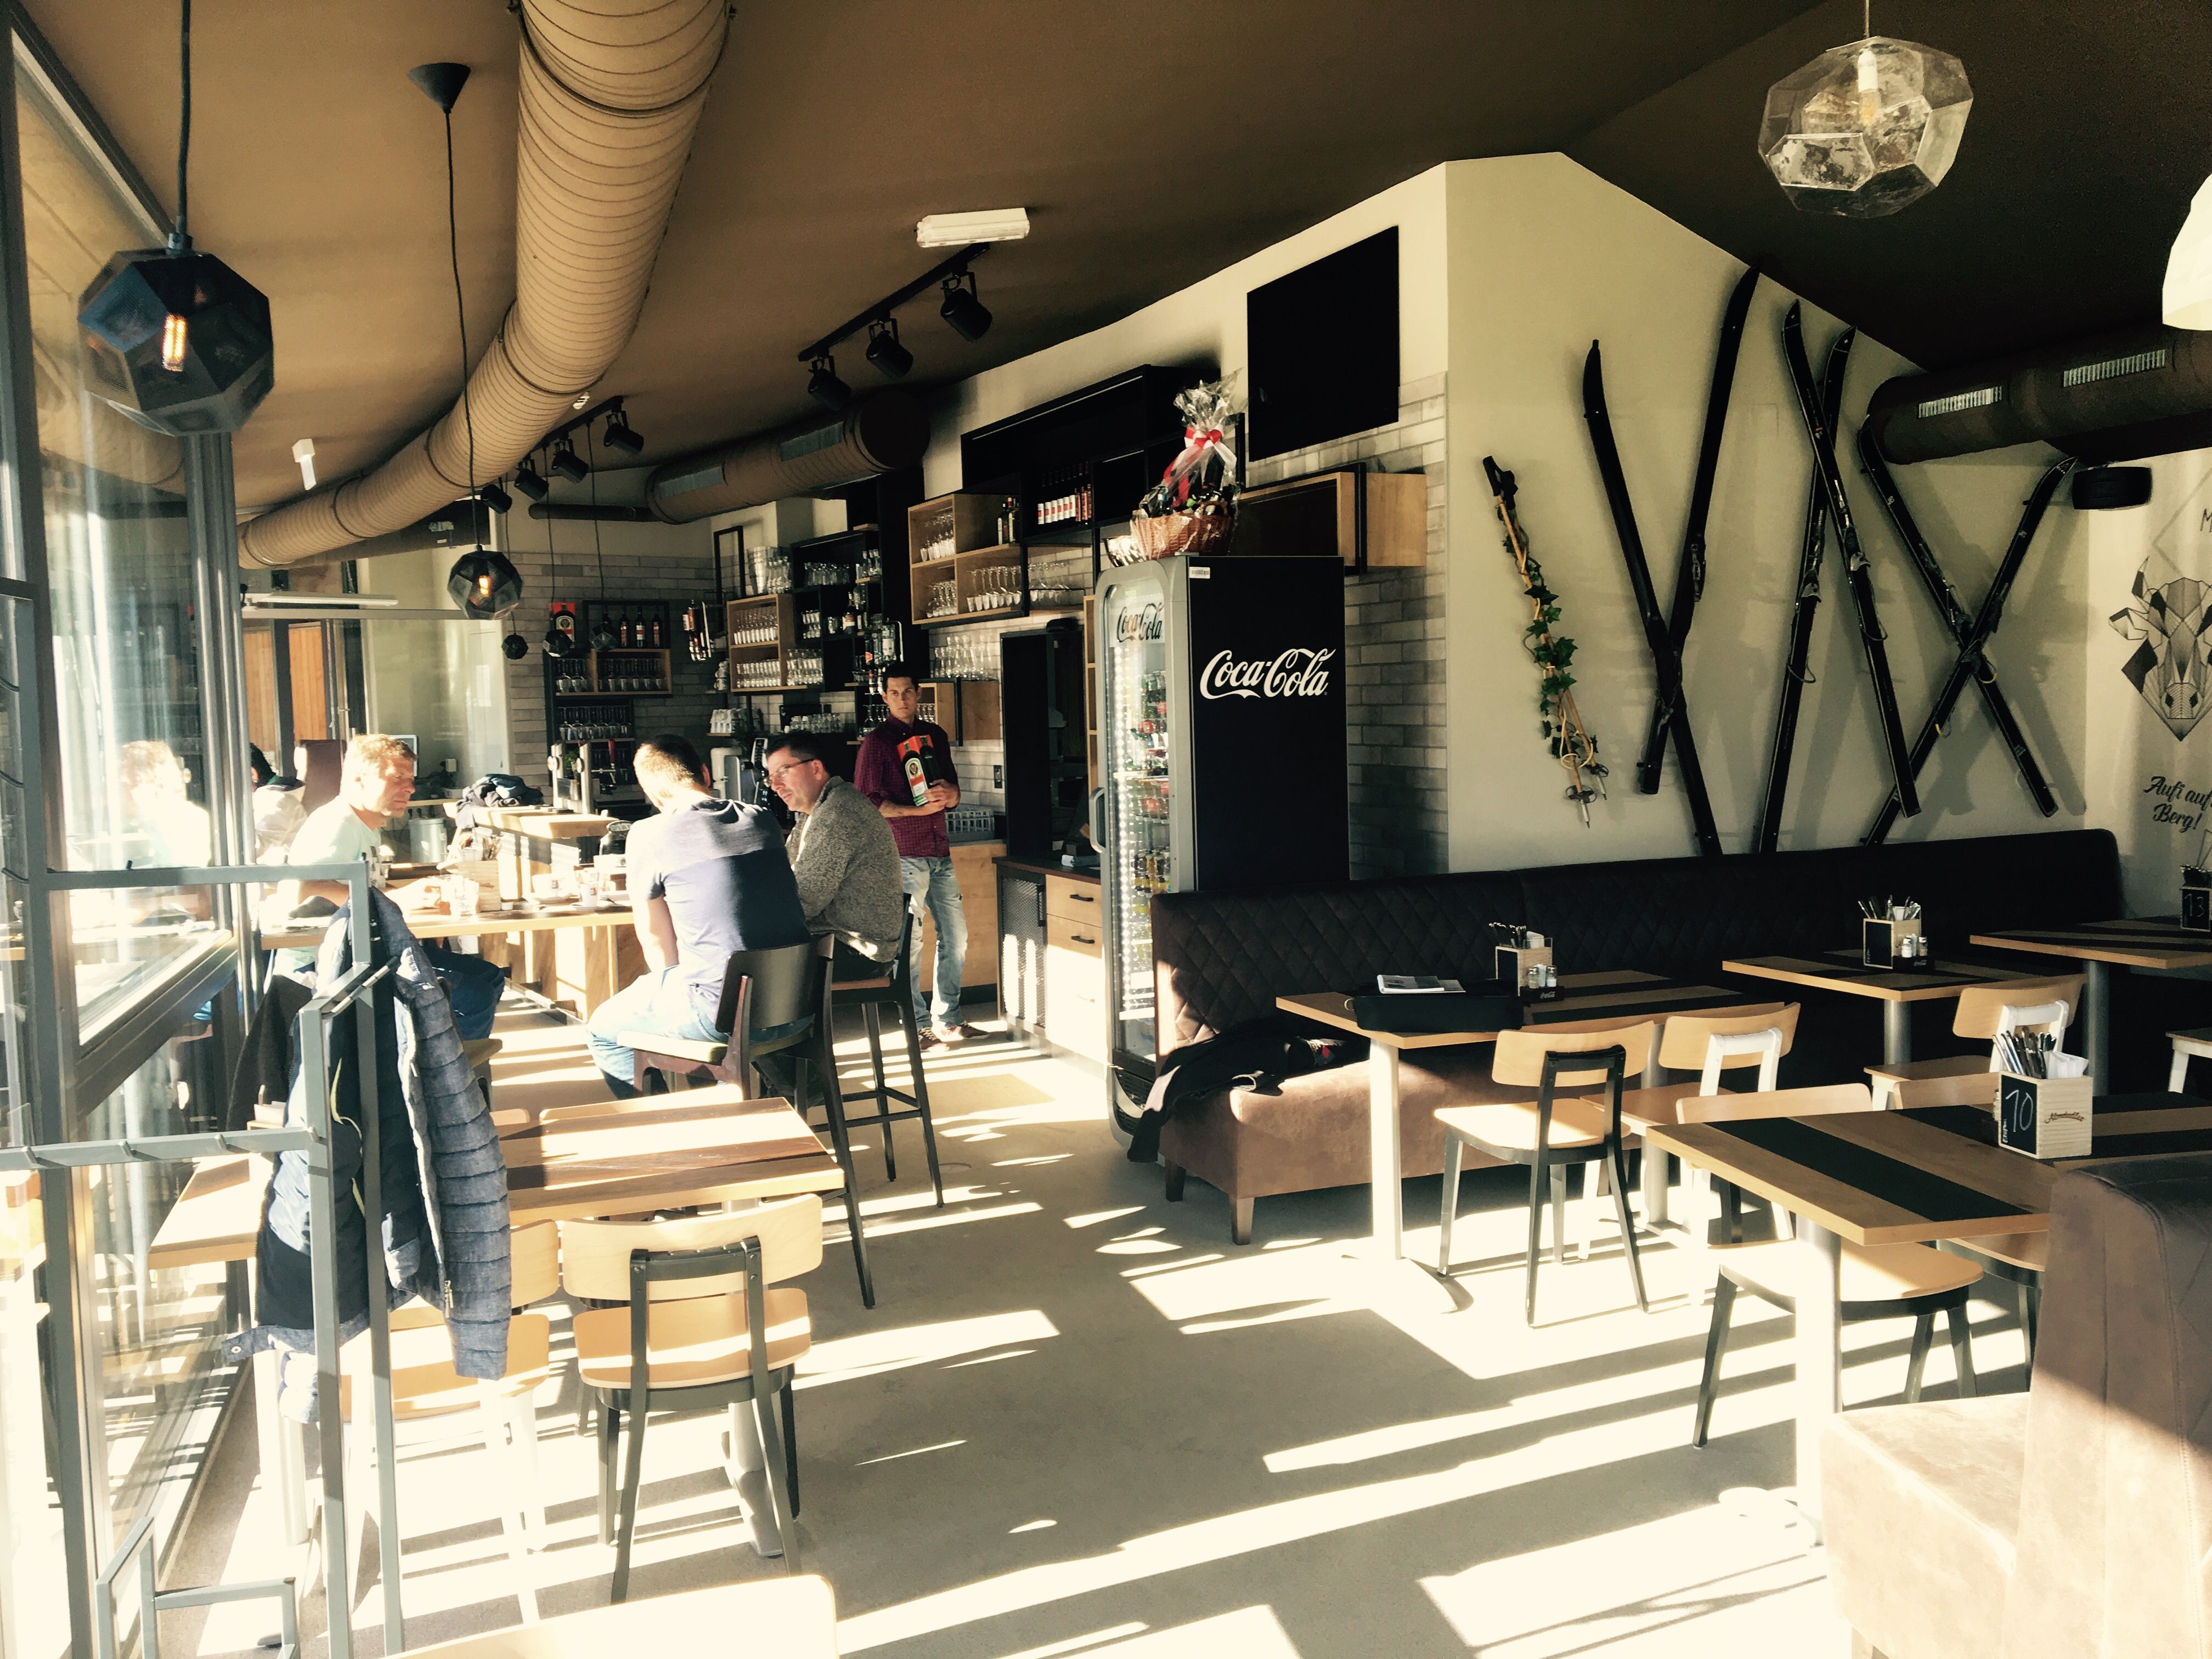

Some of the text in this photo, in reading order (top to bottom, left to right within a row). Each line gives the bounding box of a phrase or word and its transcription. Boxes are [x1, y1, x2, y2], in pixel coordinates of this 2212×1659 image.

[1200, 648, 1336, 699] Coca-Cola
[2185, 790, 2212, 811] auf
[2153, 803, 2203, 833] Berg!
[2184, 893, 2205, 917] 13
[2005, 1089, 2034, 1133] 10
